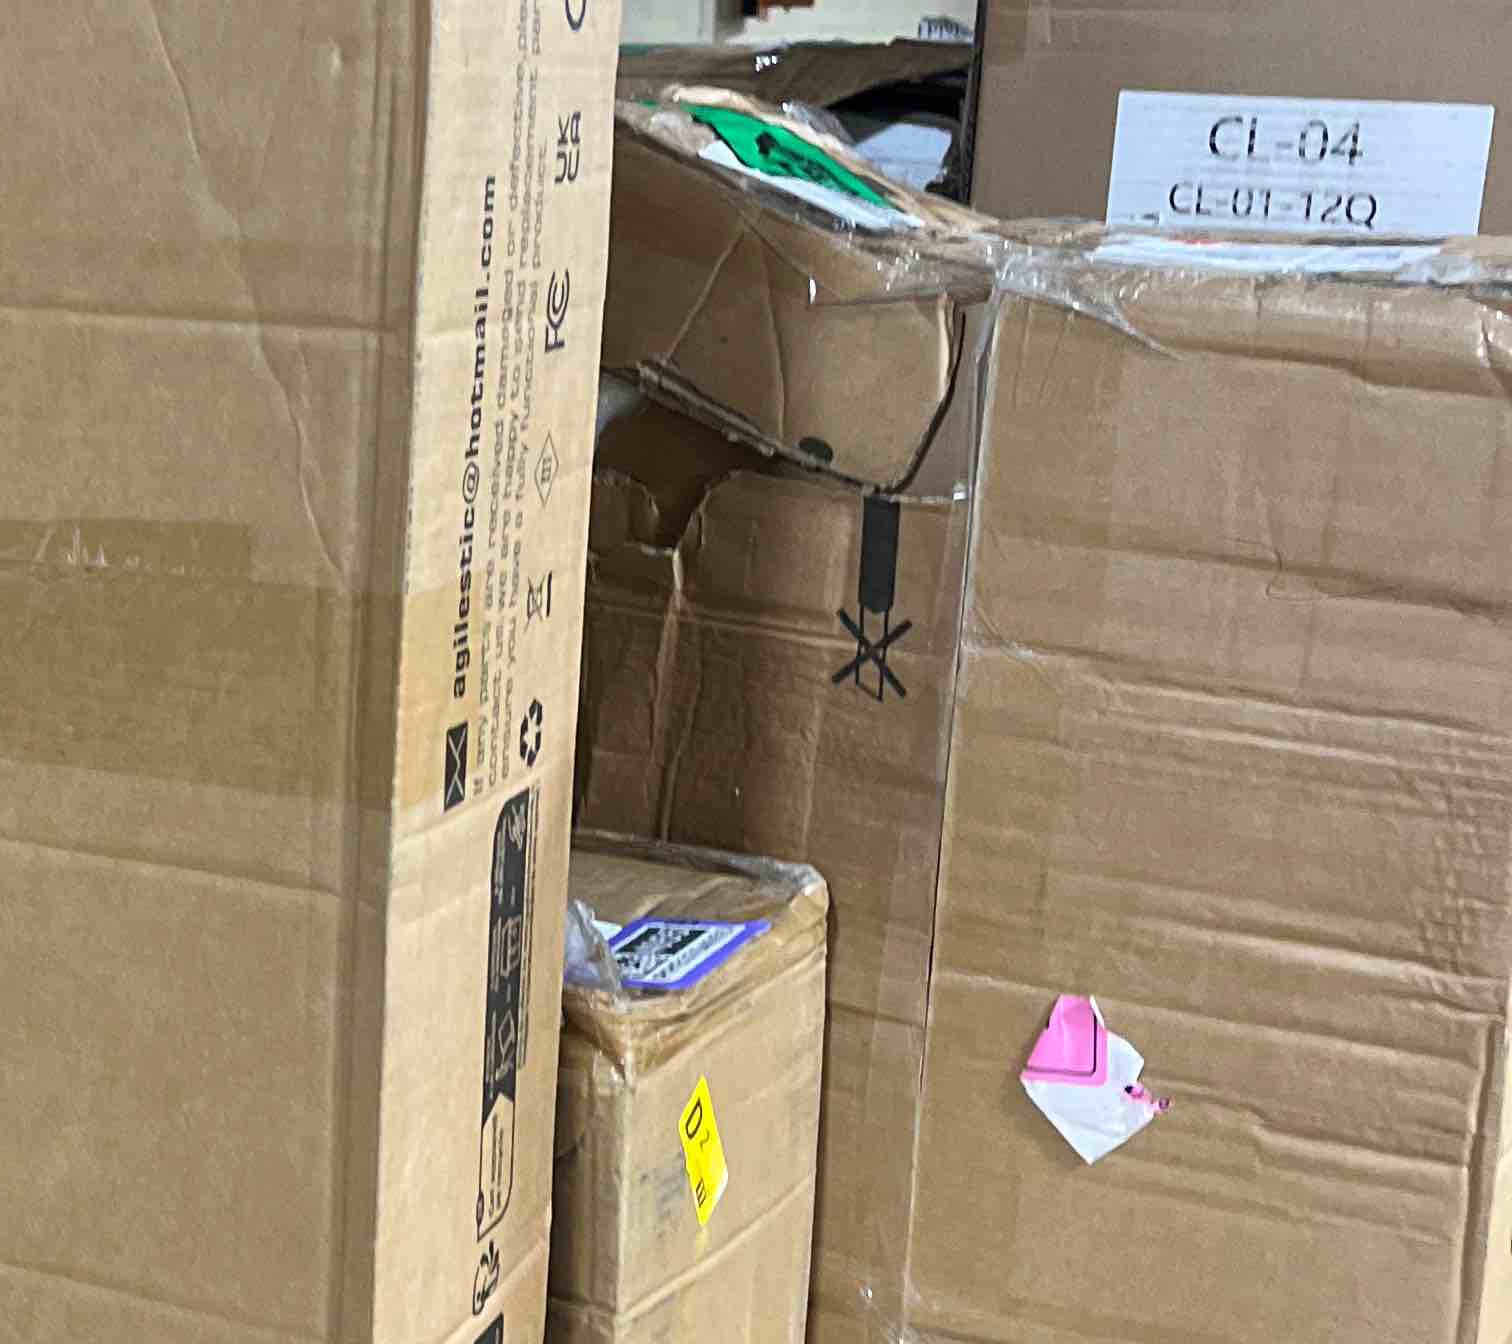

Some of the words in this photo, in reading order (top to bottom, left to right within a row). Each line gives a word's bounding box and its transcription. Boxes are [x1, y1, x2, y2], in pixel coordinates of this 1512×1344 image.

[1209, 115, 1363, 166] CL-04
[1168, 182, 1377, 230] CL-01-12Q
[453, 175, 495, 698] agilestic@hotmail.com
